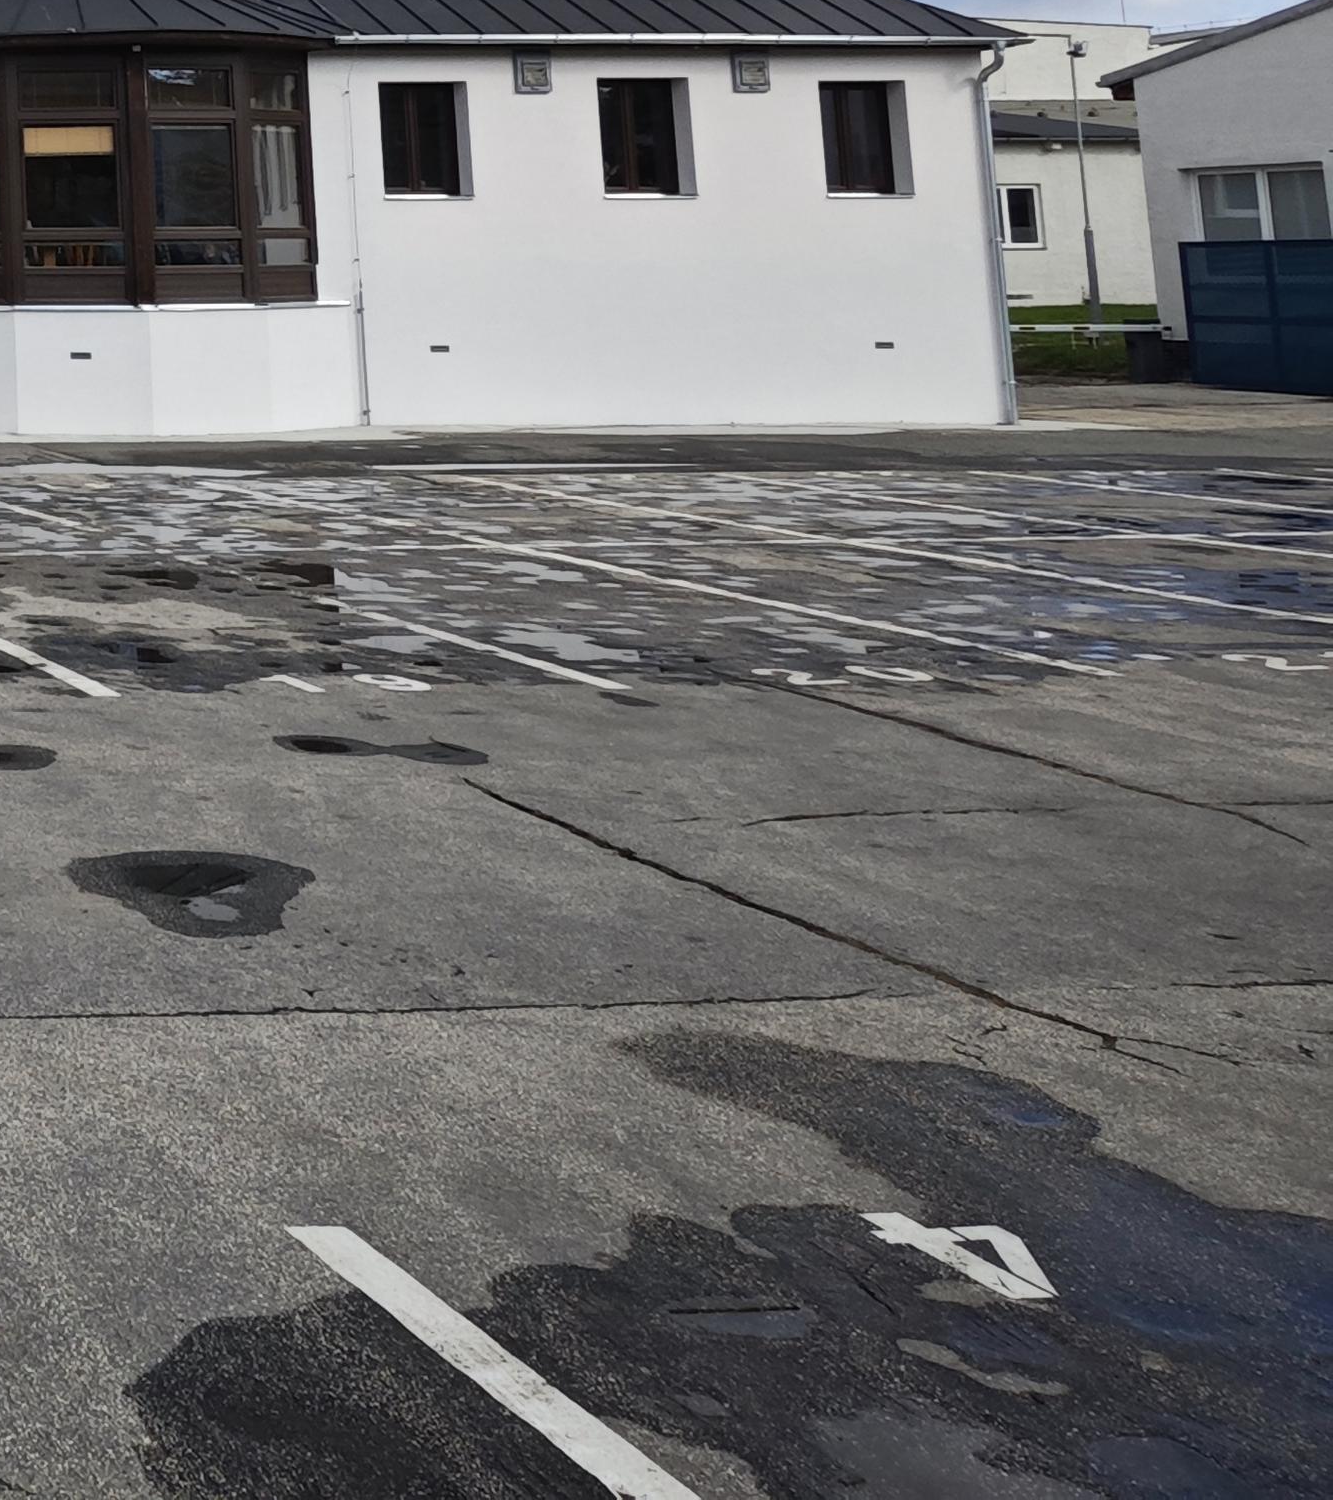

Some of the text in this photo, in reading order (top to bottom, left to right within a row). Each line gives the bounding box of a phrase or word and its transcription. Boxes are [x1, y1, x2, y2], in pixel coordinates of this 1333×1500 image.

[1221, 651, 1333, 671] 2
[259, 674, 432, 692] 19
[750, 665, 934, 685] 20
[860, 1212, 1060, 1299] 4
